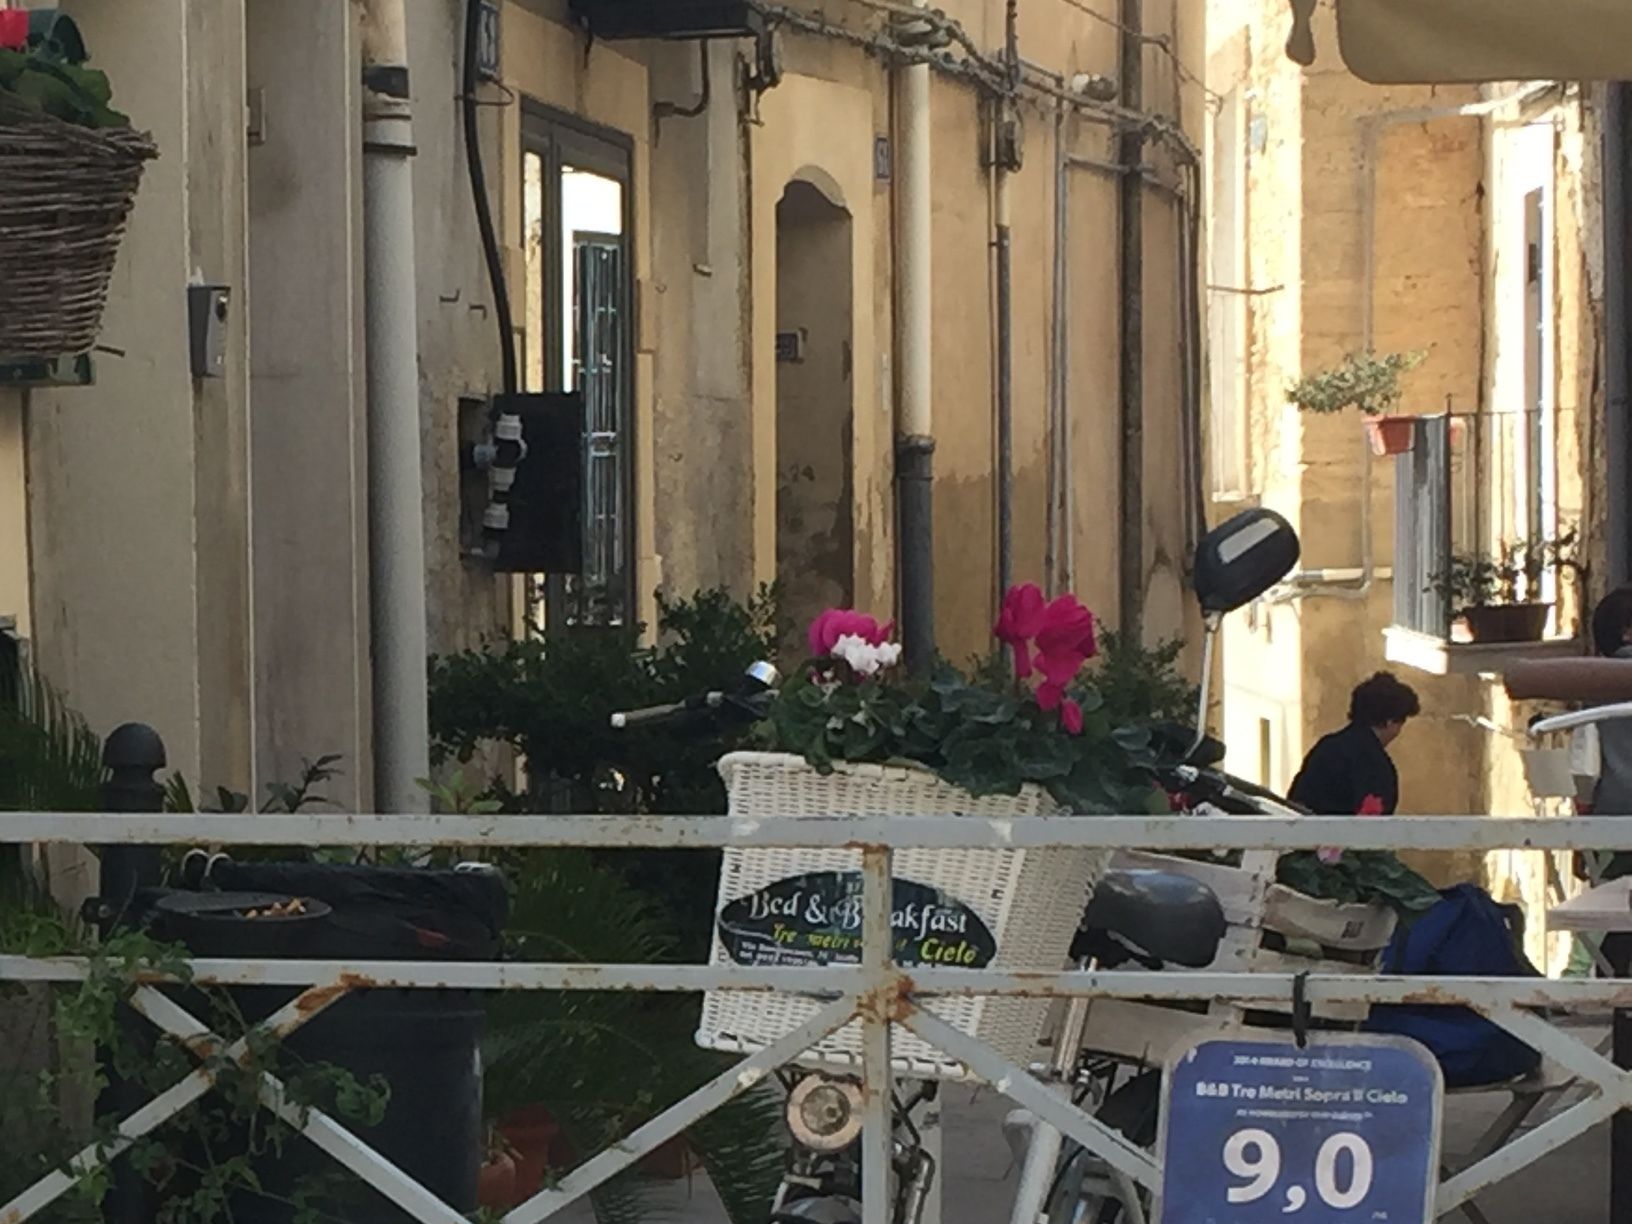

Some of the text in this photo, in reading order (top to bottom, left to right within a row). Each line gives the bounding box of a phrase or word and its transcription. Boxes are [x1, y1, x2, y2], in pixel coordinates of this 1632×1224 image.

[750, 891, 802, 919] Bed
[920, 938, 978, 963] Cielo
[1231, 1083, 1257, 1099] Tre
[1258, 1085, 1301, 1100] Metri
[1304, 1088, 1350, 1103] Sopra
[1367, 1089, 1409, 1104] Cielo
[1223, 1128, 1373, 1213] 9,0
